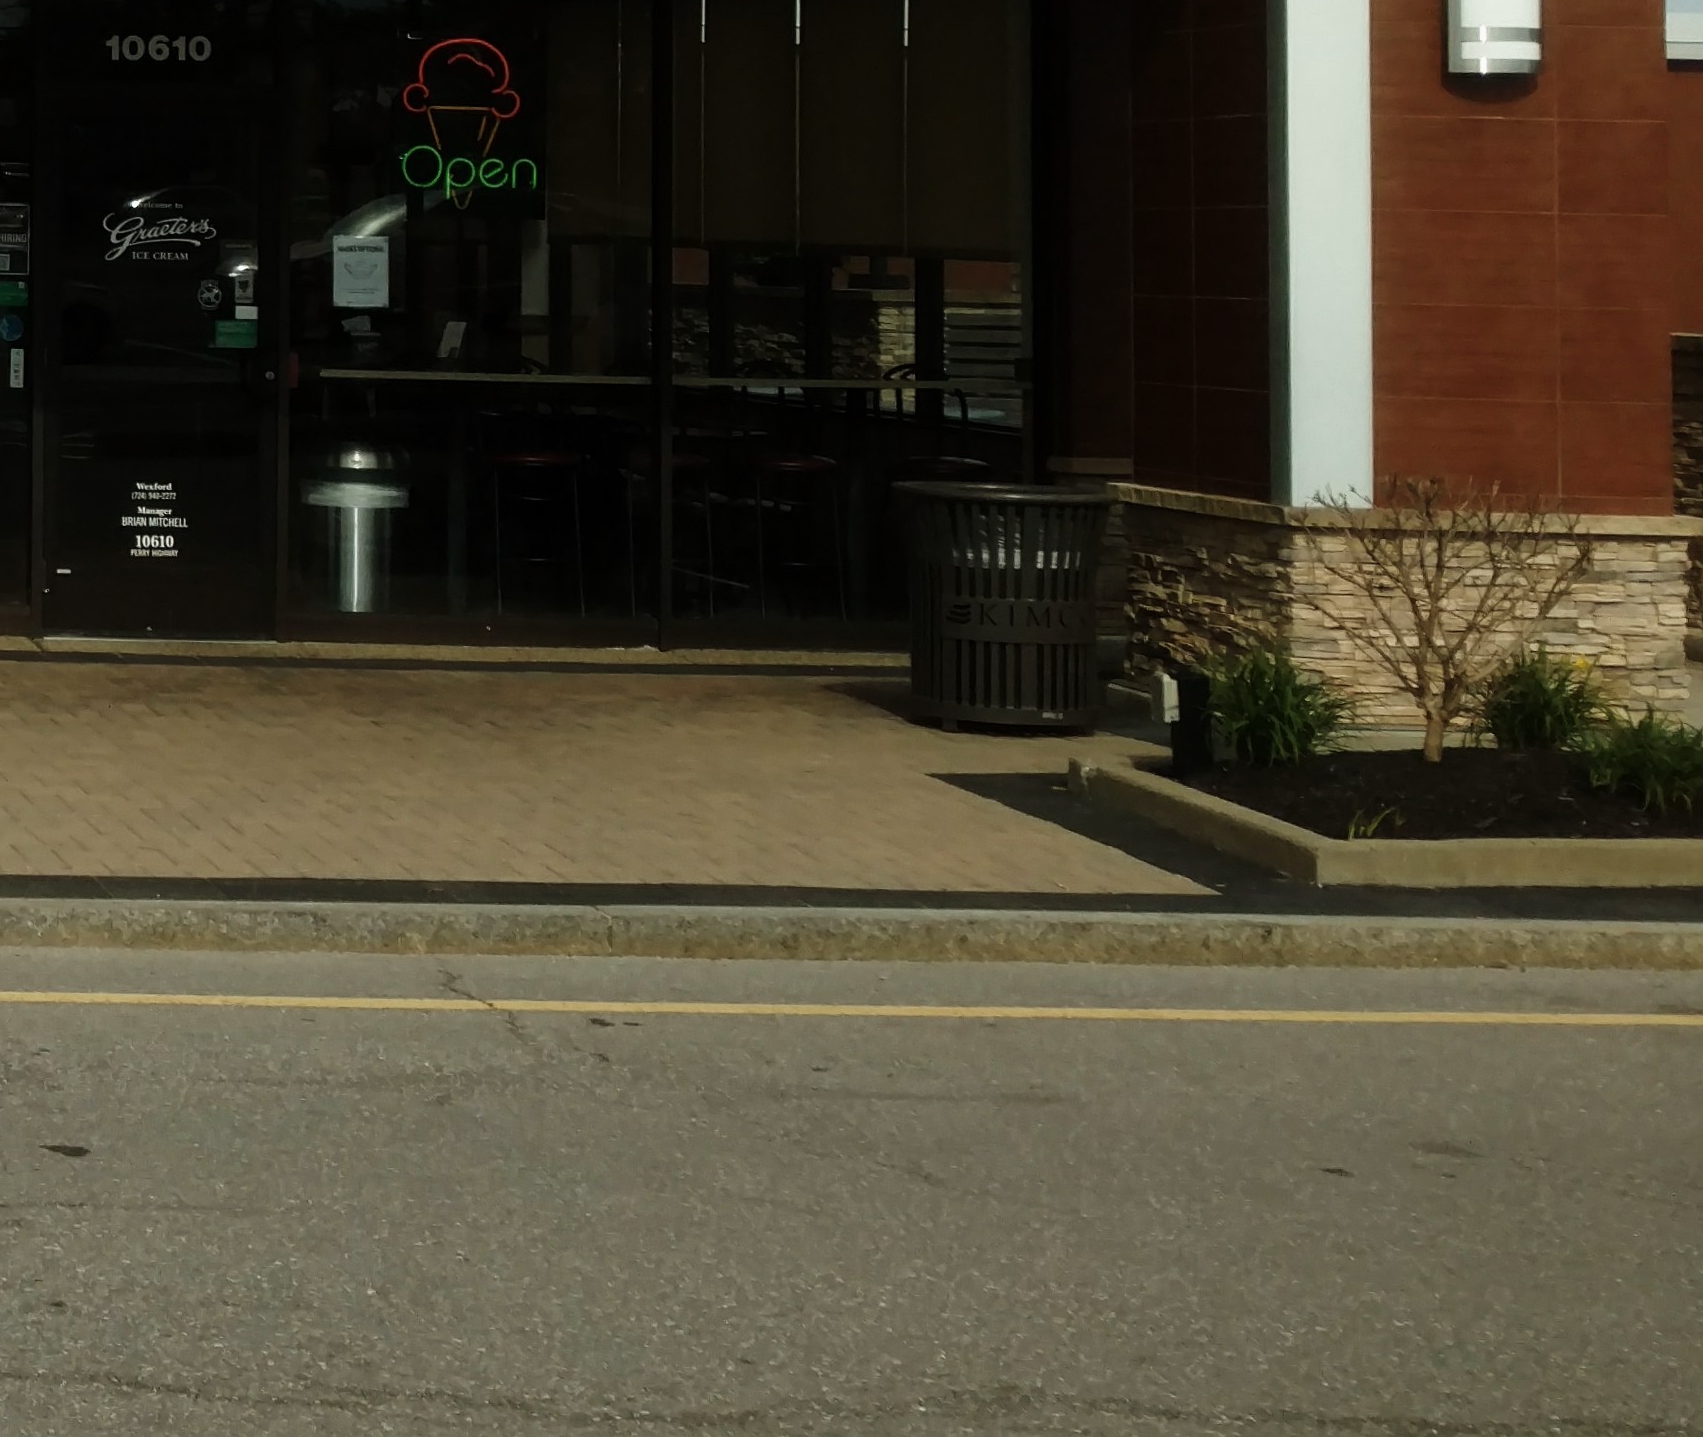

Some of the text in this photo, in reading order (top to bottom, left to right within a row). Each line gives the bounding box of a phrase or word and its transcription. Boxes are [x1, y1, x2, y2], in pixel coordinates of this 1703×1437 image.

[105, 34, 212, 62] 10610
[401, 144, 538, 201] Open
[103, 212, 217, 261] Graeter's
[132, 251, 189, 261] ICE CREAM
[136, 482, 172, 491] Wexford
[137, 506, 172, 517] Manager
[122, 516, 188, 528] BRIAN MITCHELL
[135, 534, 175, 548] 10610
